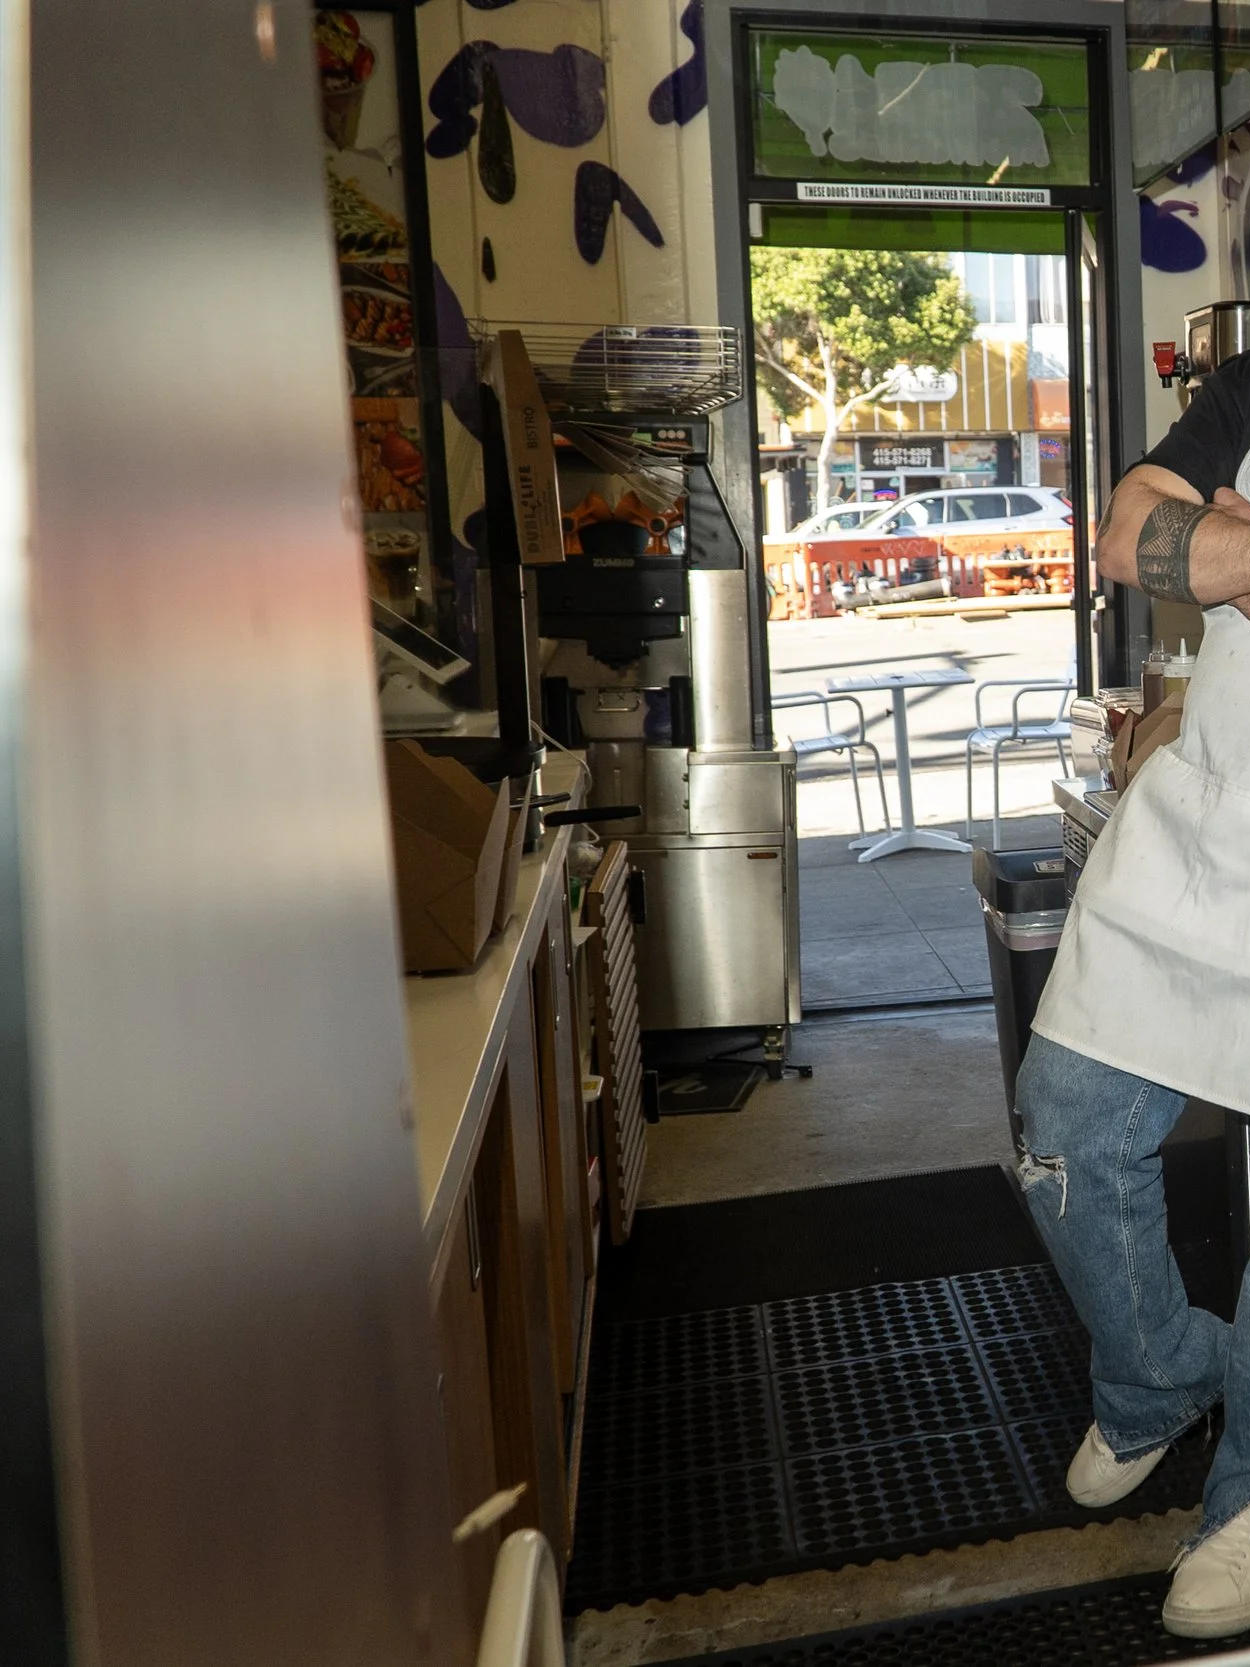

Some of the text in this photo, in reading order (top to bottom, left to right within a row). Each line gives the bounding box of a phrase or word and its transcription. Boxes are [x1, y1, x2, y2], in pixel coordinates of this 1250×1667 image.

[804, 185, 1045, 203] THESE DOORS TO REMAIN UNLOCKED WHENEVER THE BUILDING IS OCCUPIED
[523, 406, 538, 449] BISTRO
[518, 464, 534, 499] LIFE
